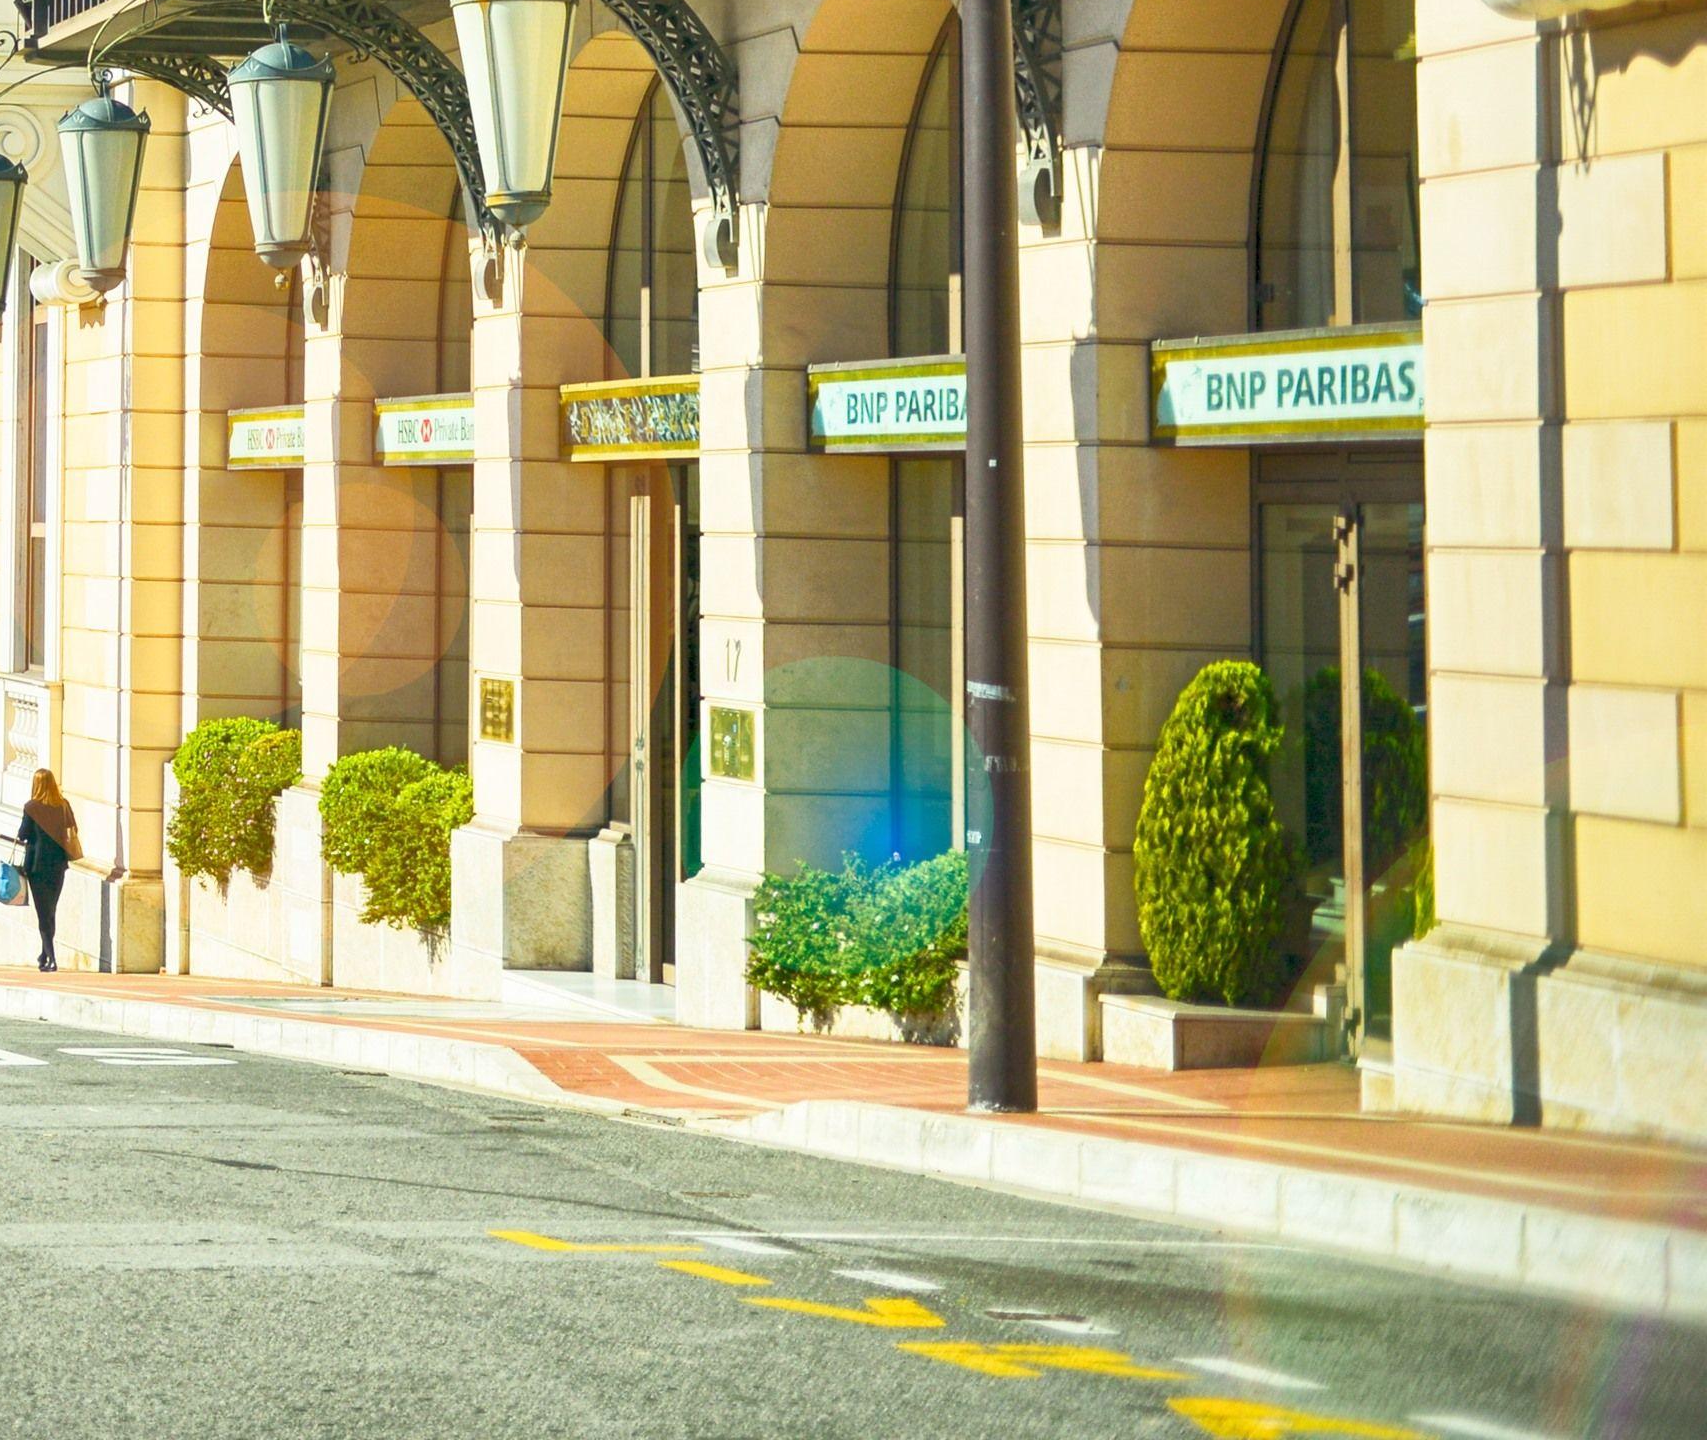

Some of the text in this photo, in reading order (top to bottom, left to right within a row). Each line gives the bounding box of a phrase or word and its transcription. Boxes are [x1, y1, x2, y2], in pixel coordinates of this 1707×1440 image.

[1207, 360, 1416, 412] BNP PARIBAS
[847, 391, 888, 425] BNP
[247, 428, 264, 450] HSBC
[397, 419, 419, 444] HSBC
[434, 417, 458, 442] Private
[726, 638, 741, 682] 17
